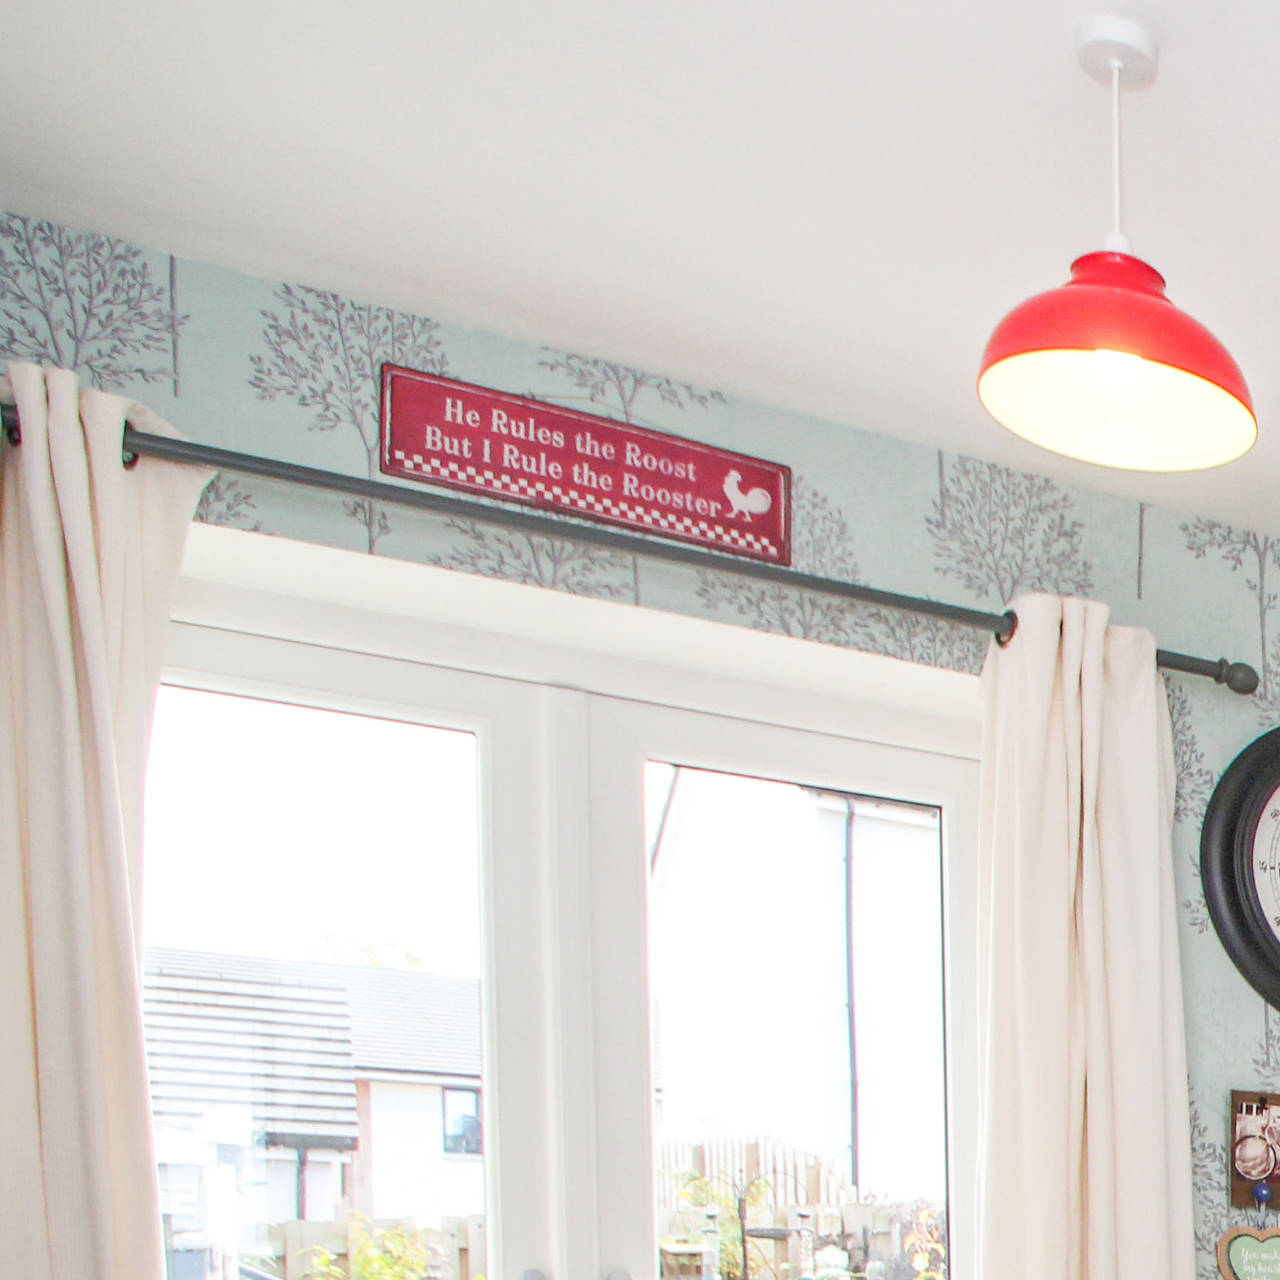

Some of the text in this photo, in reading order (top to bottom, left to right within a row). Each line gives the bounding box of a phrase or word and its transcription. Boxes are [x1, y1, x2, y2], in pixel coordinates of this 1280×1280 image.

[424, 424, 722, 517] But I Rule the Rooster
[444, 396, 697, 482] He Rules the Roost
